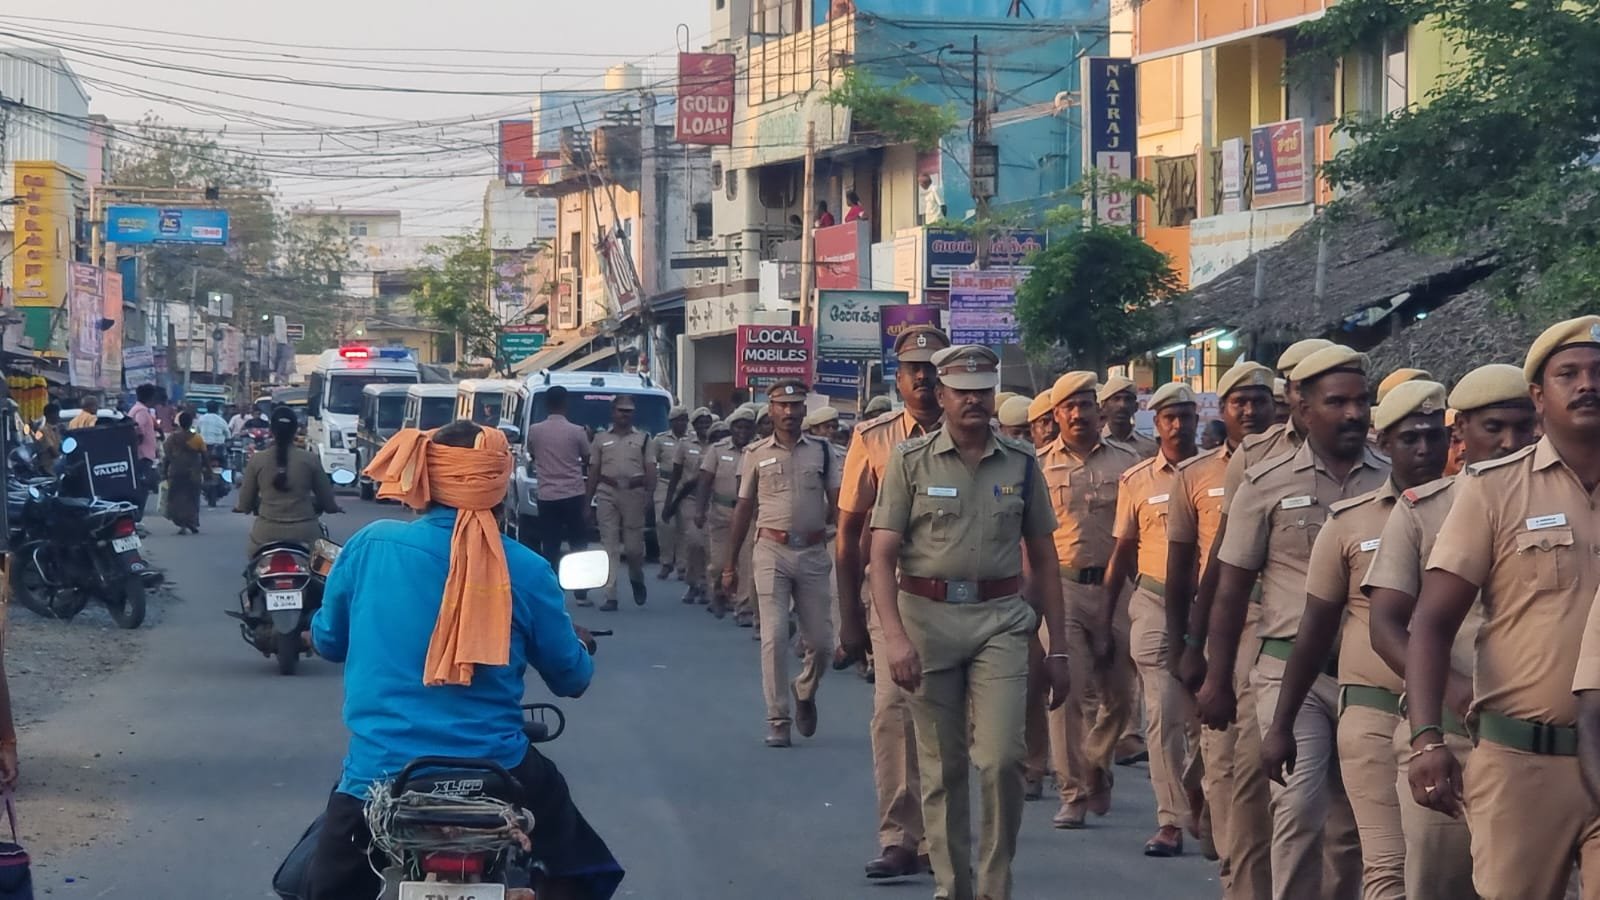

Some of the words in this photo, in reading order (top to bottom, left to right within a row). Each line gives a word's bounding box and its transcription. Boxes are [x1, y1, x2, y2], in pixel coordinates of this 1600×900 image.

[682, 95, 729, 113] GOLD
[1106, 64, 1121, 149] NATRAJ
[682, 117, 728, 135] LOAN
[748, 329, 804, 344] LOCAL
[745, 349, 807, 362] MOBILES
[746, 366, 768, 374] SALES
[776, 366, 805, 374] SERVICE
